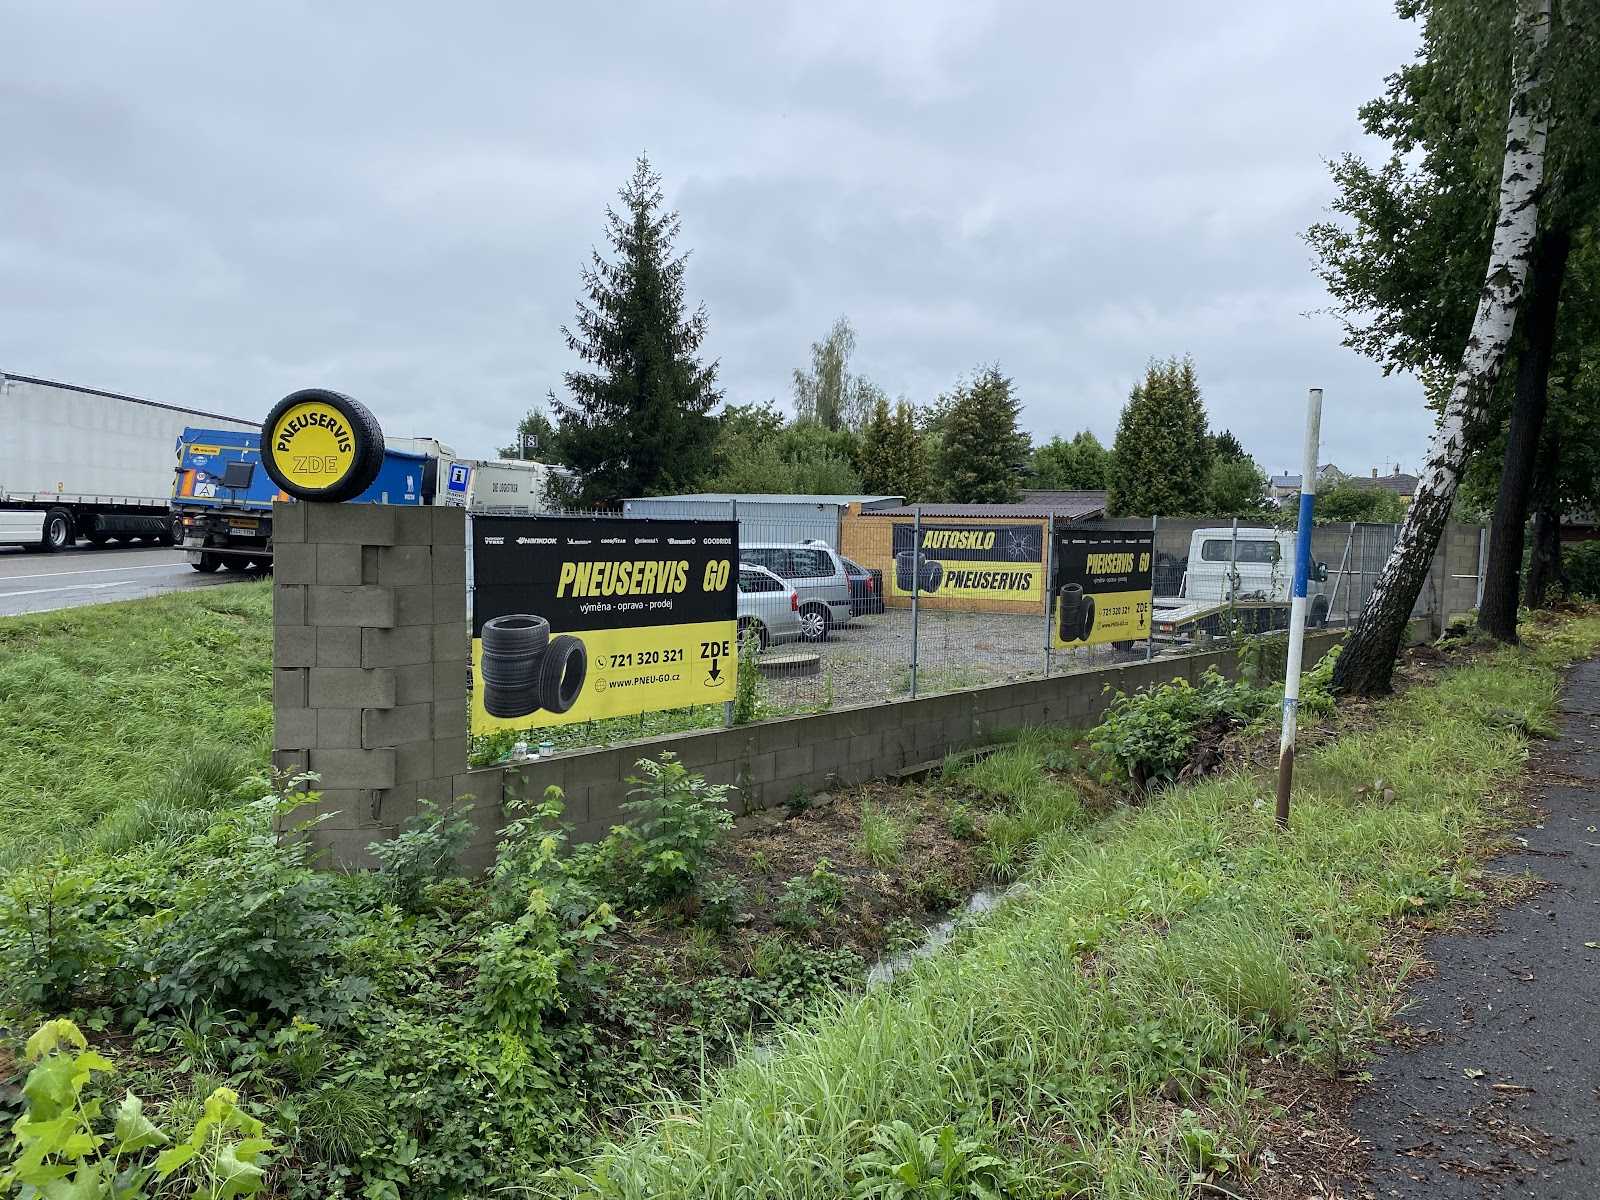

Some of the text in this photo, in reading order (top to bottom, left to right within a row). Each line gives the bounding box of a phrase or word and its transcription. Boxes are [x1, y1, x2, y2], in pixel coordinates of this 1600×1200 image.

[277, 413, 352, 453] PNEUSERVIS
[293, 456, 338, 473] ZDE
[922, 530, 996, 549] AUTOSKLO
[1086, 552, 1151, 574] PNEUSERVIS GO
[556, 559, 731, 598] PNEUSERVIS GO
[944, 571, 1033, 591] PNEUSERVIS
[580, 602, 612, 615] výměna
[617, 602, 644, 613] oprava
[649, 599, 673, 611] prodej
[1136, 603, 1148, 613] ZDE
[610, 649, 684, 668] 721 320 321
[700, 641, 730, 659] ZDE
